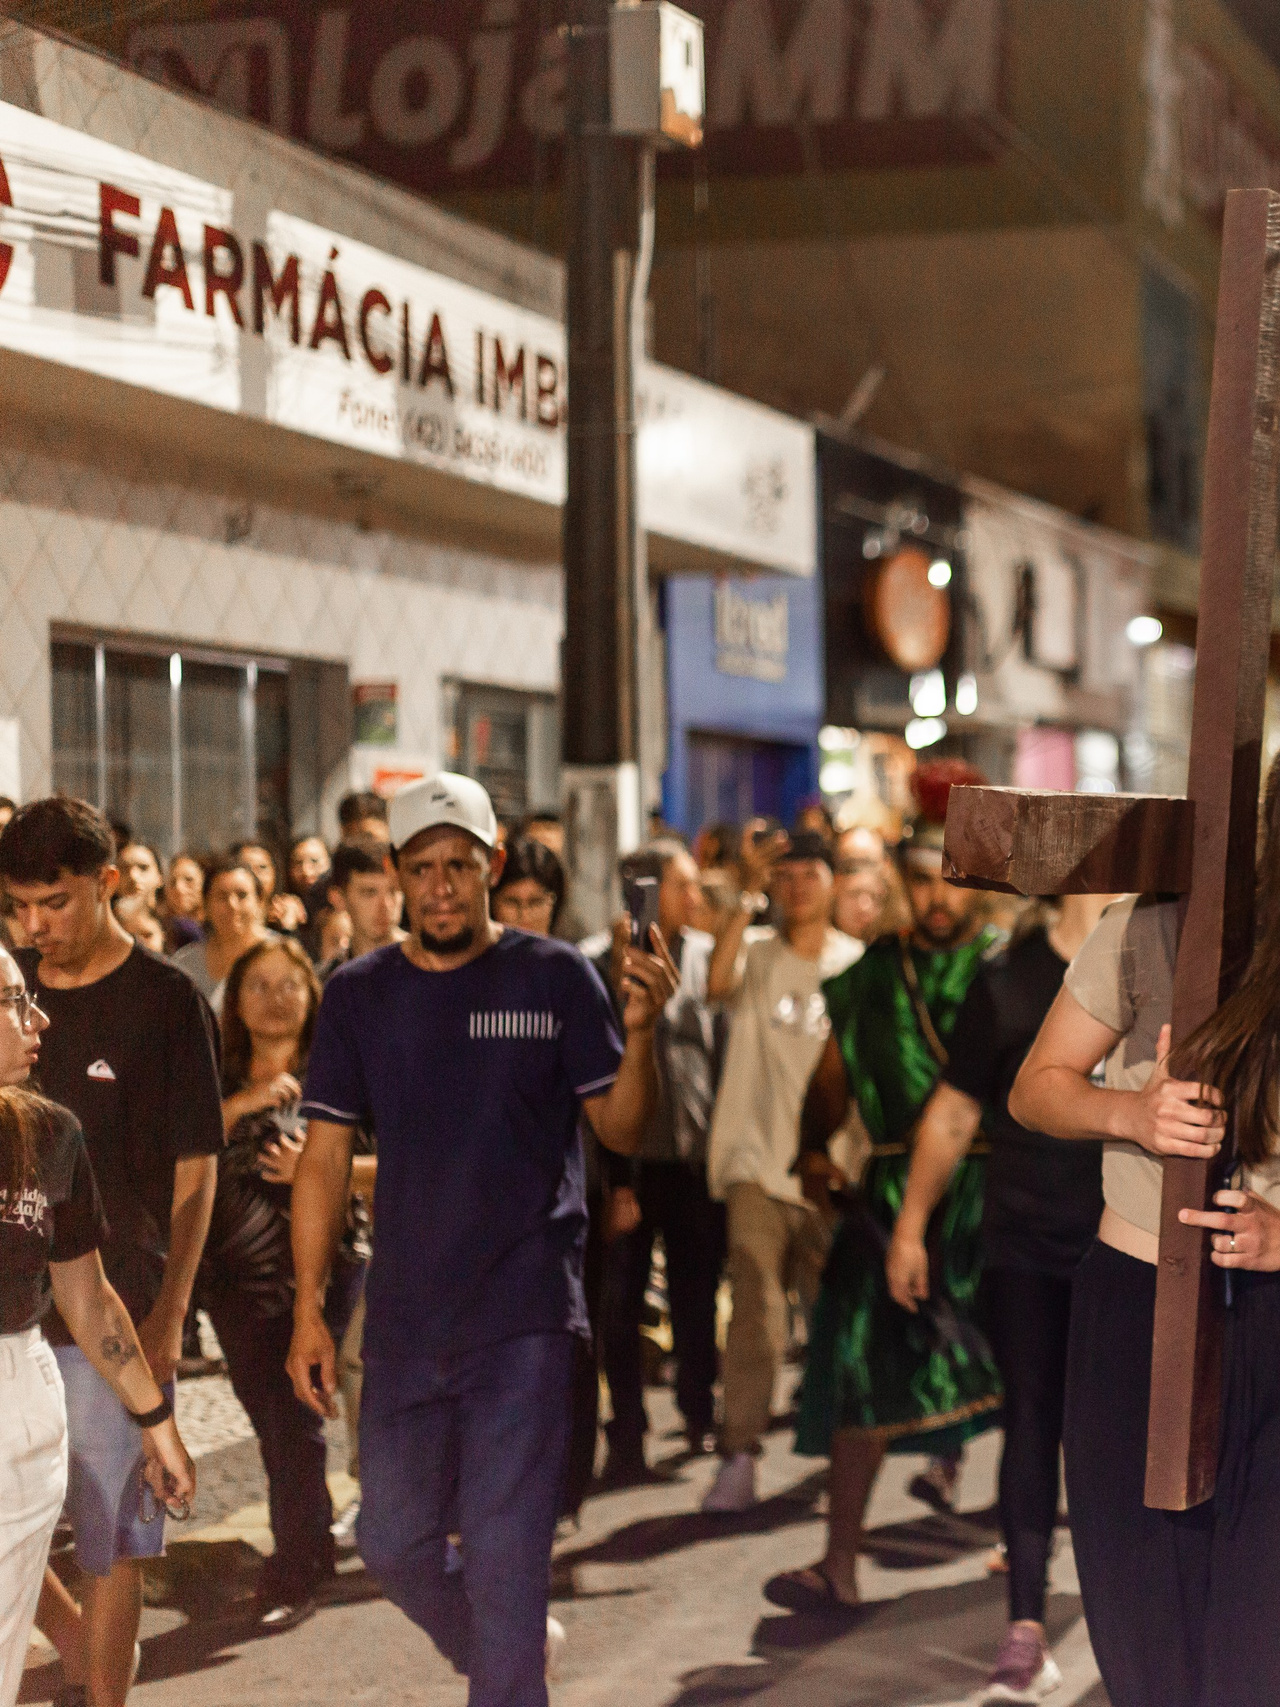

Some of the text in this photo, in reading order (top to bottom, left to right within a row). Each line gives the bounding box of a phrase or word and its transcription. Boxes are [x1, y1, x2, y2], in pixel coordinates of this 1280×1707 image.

[308, 0, 572, 172] Loja
[98, 181, 568, 428] FARMÁCIA IMB
